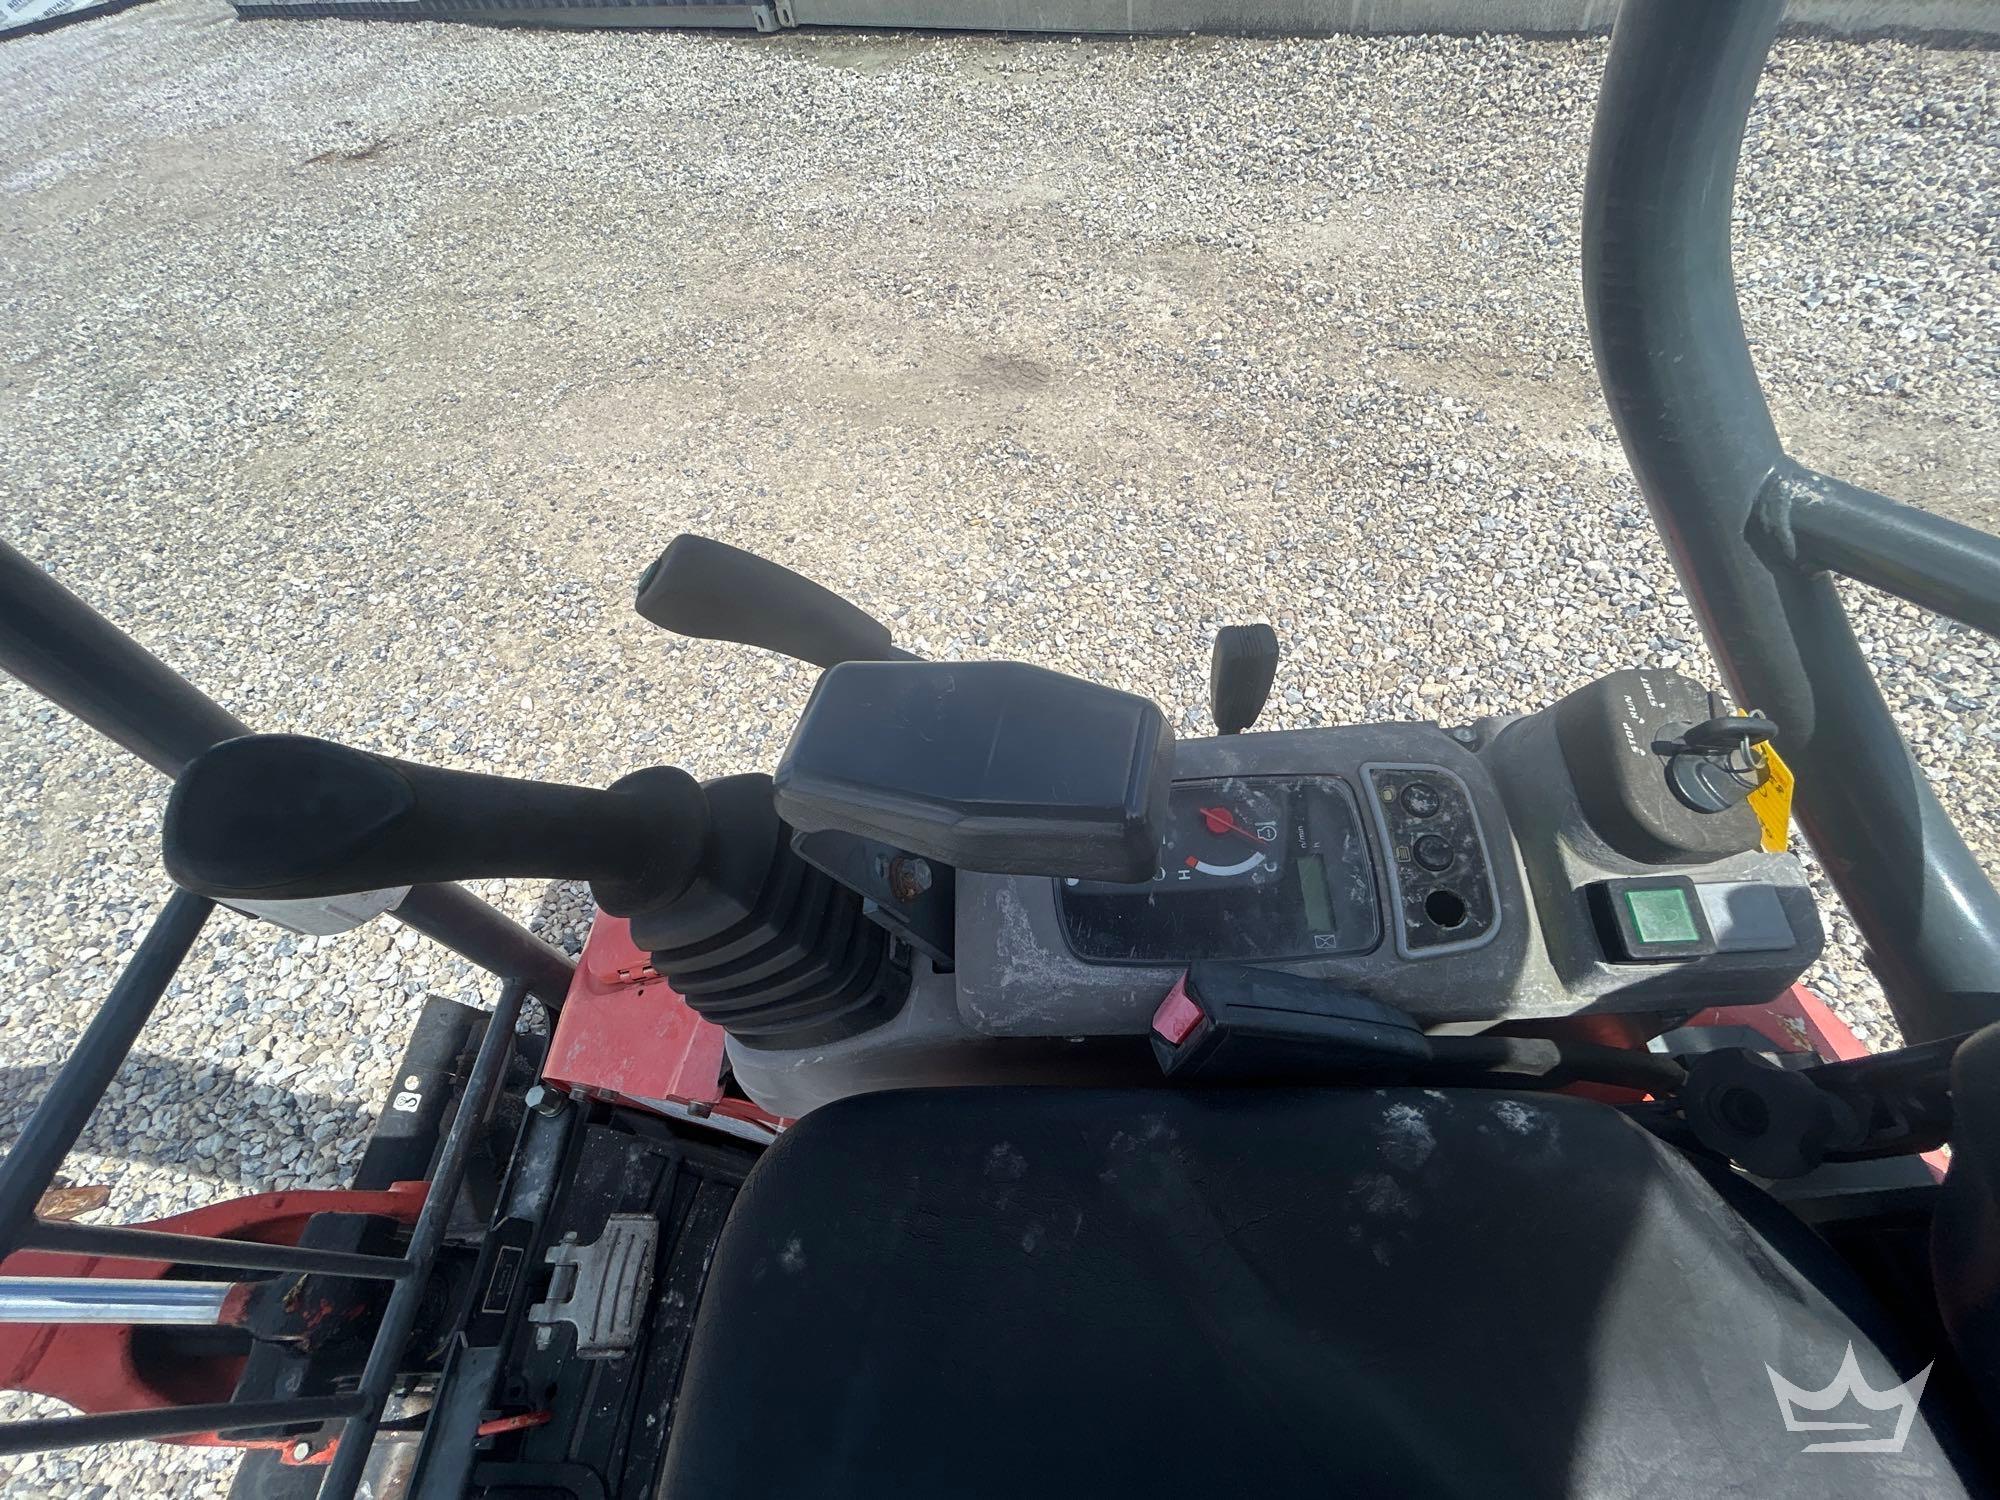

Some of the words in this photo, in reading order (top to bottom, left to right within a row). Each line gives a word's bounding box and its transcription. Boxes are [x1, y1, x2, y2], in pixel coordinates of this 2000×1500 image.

[1639, 676, 1659, 708] START
[1623, 694, 1639, 719] RUN
[1622, 722, 1640, 753] STOP
[1178, 869, 1191, 880] H
